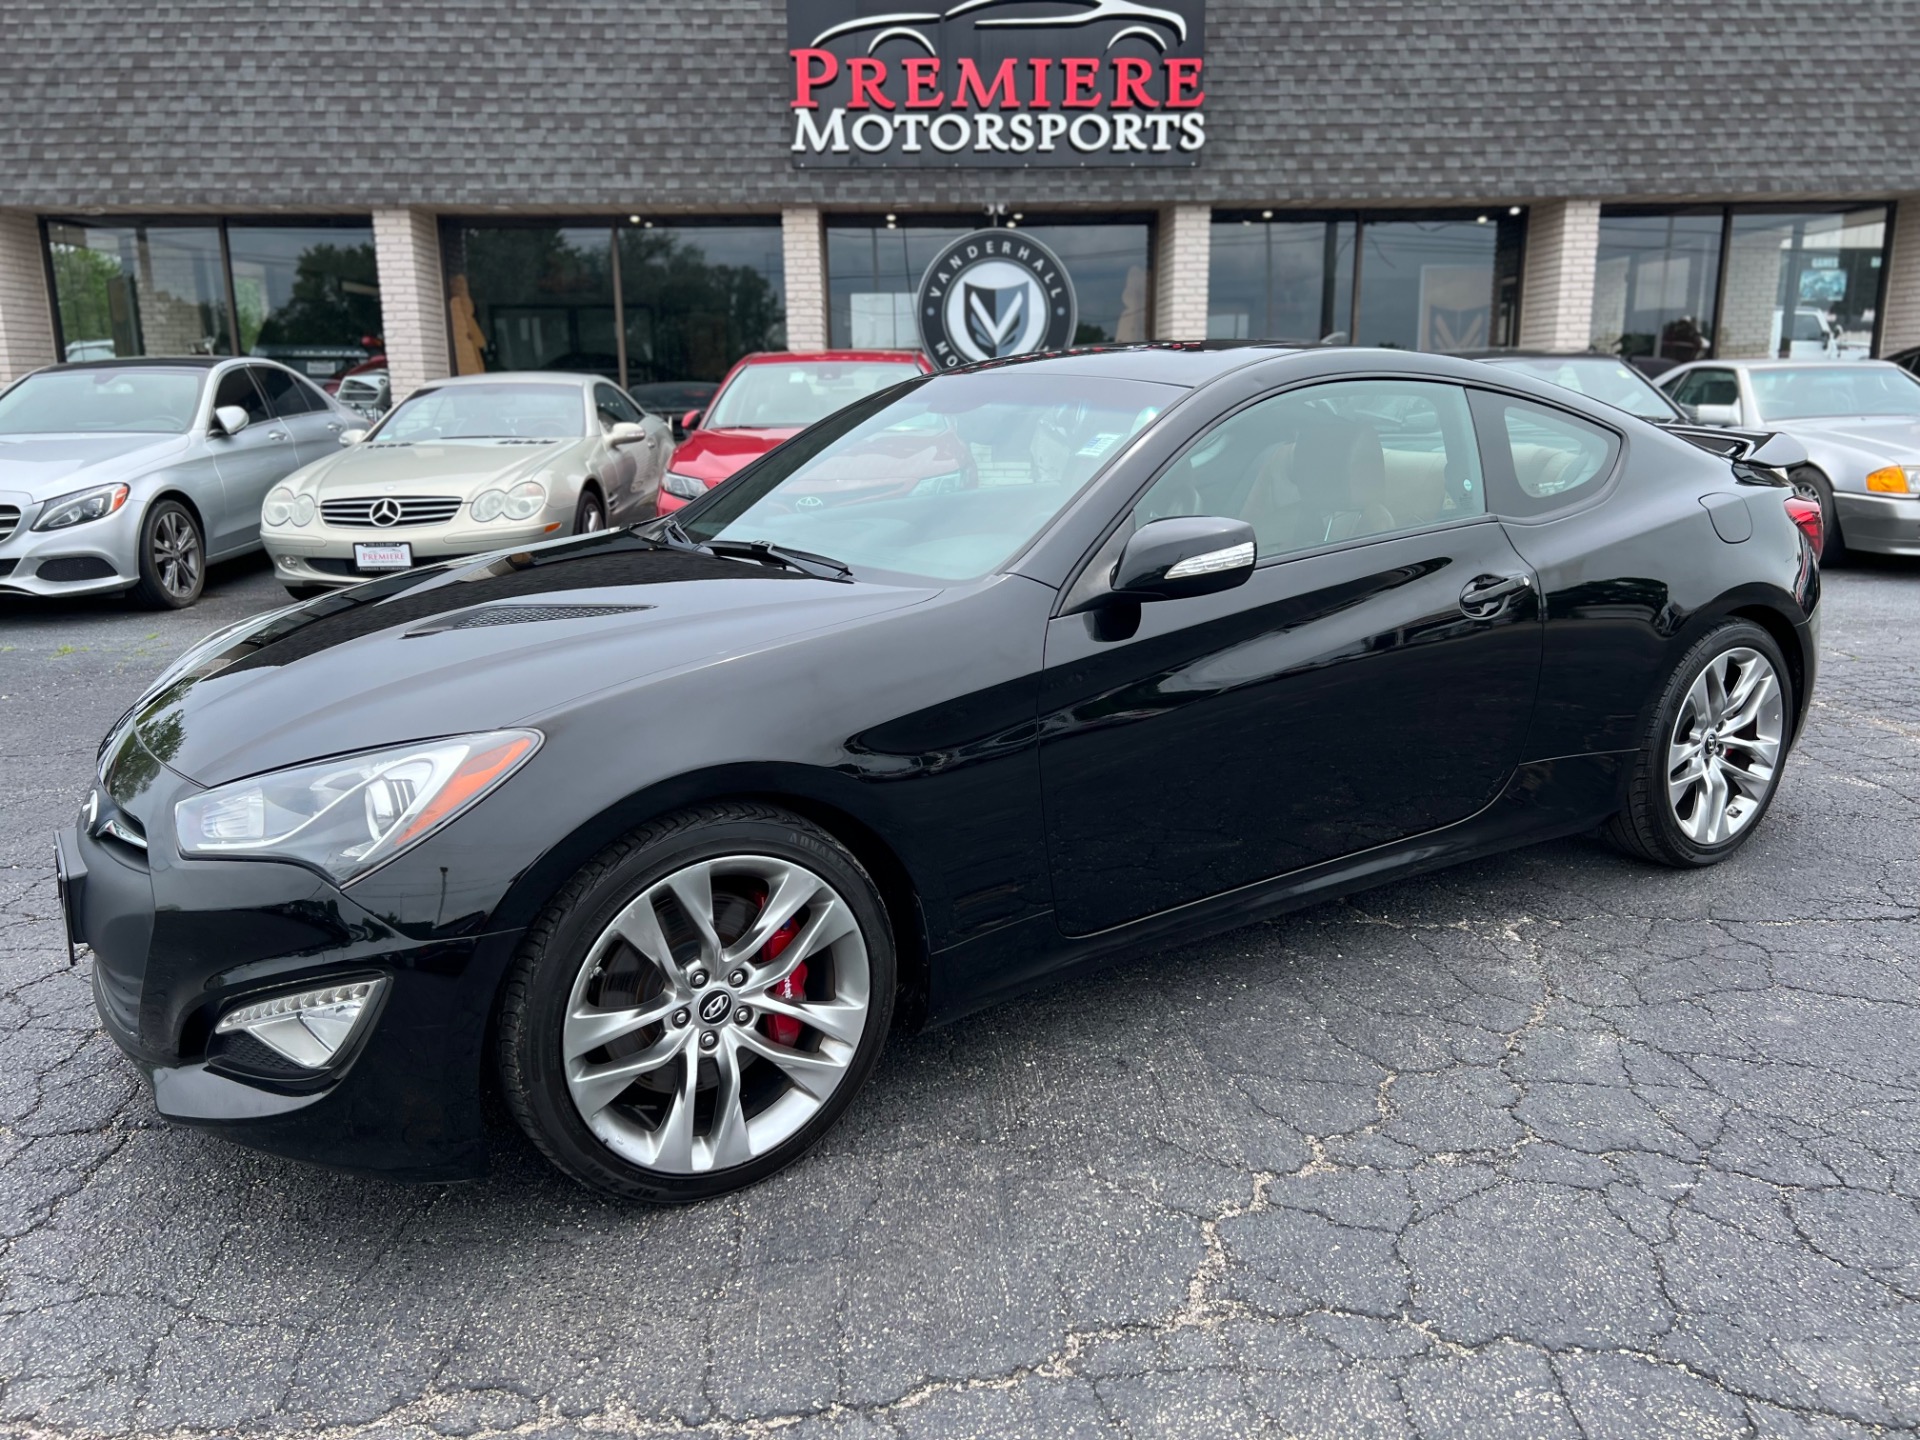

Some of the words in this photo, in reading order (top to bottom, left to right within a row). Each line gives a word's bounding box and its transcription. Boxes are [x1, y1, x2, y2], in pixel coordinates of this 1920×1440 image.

[789, 48, 1205, 109] PREMIERE
[791, 108, 1206, 153] MOTORSPORTS
[929, 241, 1062, 299] VANDERHALL
[362, 552, 405, 560] PREMIERE
